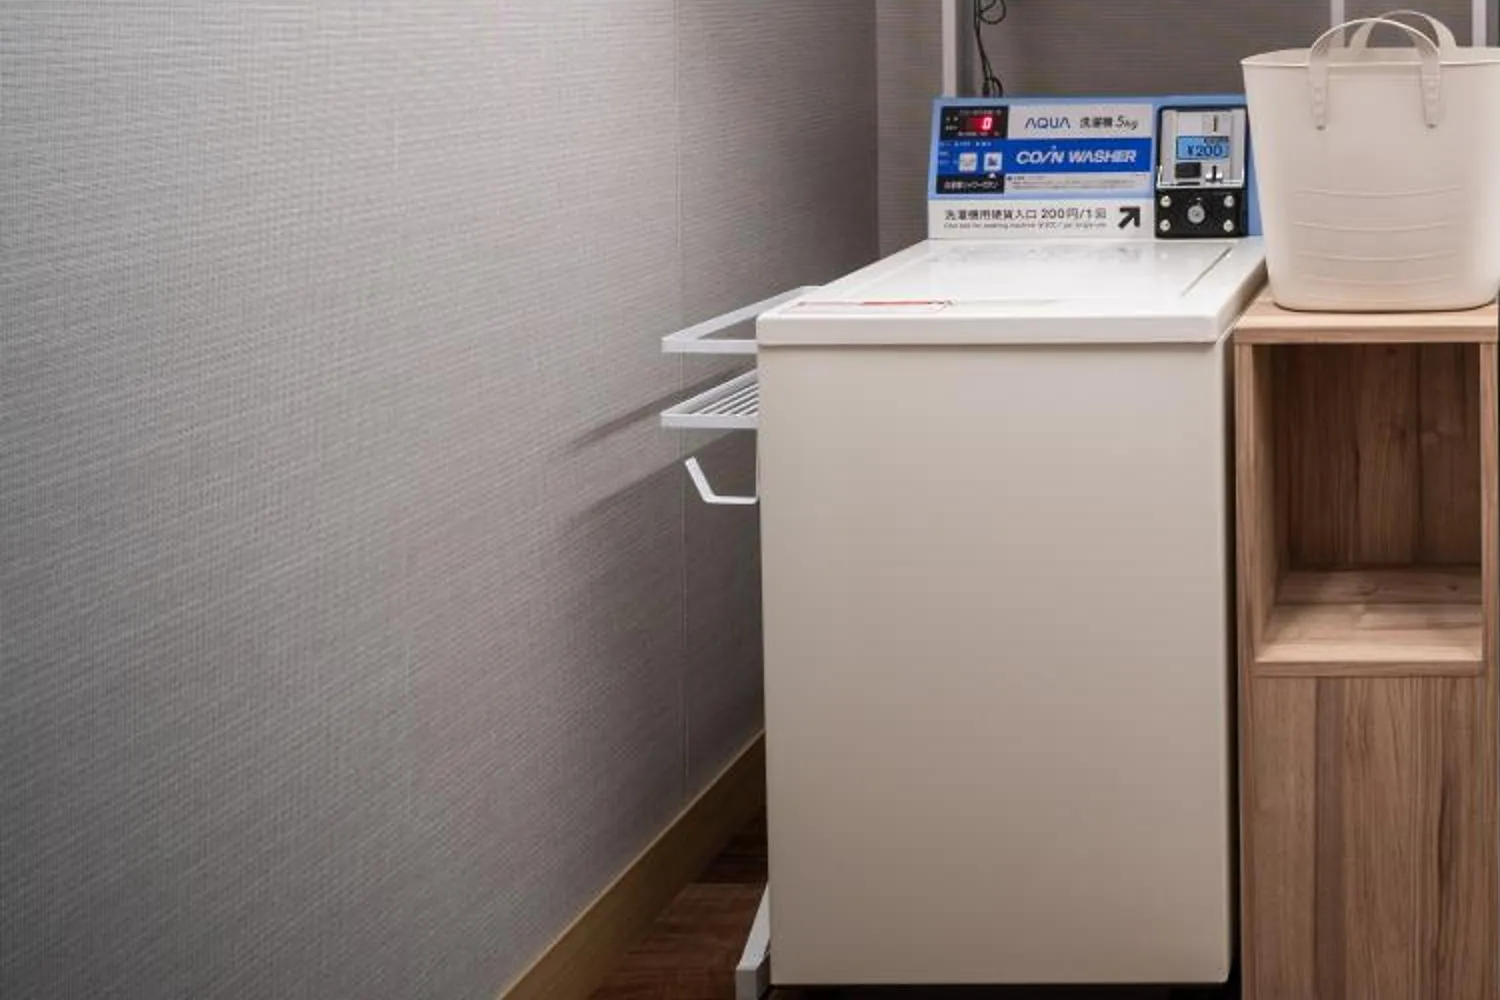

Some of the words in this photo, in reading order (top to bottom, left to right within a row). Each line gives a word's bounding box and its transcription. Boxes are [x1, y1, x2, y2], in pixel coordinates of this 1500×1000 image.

[981, 116, 993, 130] 0
[1024, 116, 1071, 129] AQUA
[1079, 115, 1113, 128] 洗濯機
[1114, 114, 1139, 131] 5kg
[1068, 148, 1137, 164] WASHER
[1186, 143, 1224, 157] ¥200
